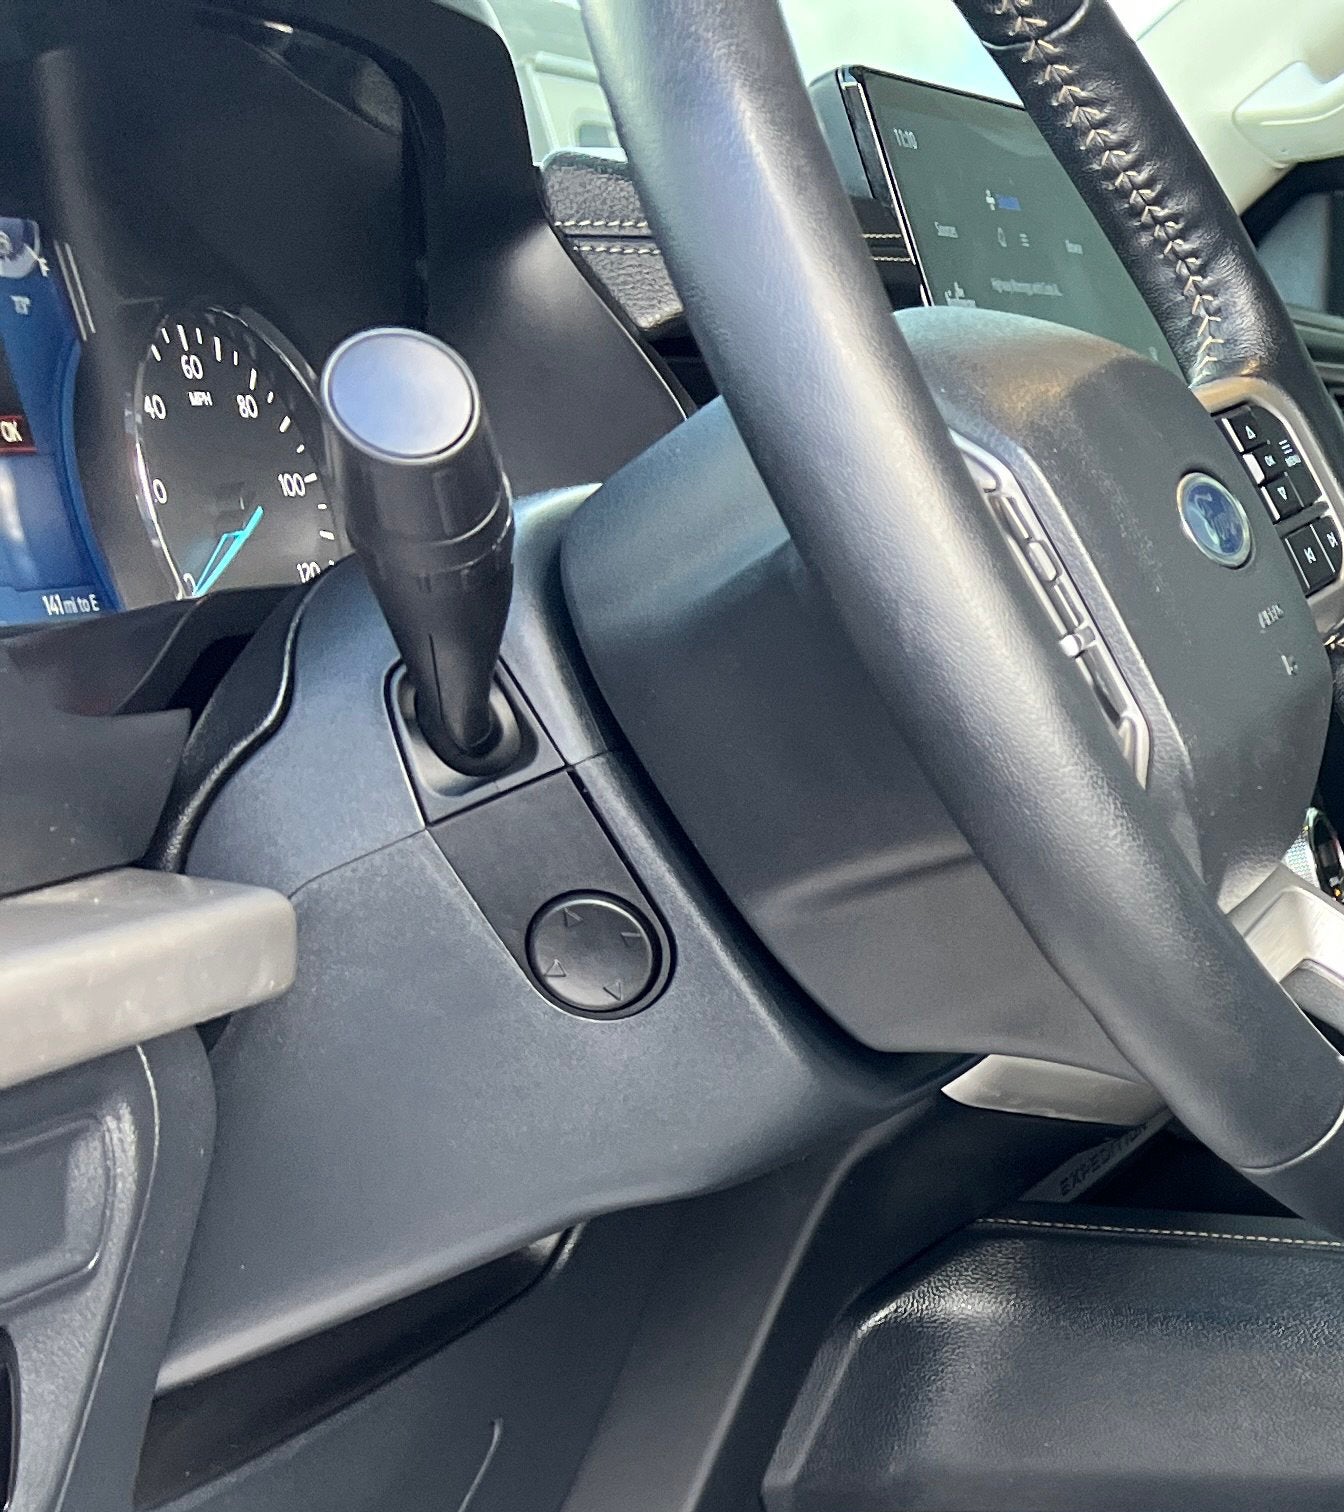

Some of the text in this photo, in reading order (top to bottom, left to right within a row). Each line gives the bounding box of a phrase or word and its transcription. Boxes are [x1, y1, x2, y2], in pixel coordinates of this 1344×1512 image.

[181, 355, 203, 379] 60
[144, 394, 166, 419] 40
[188, 391, 213, 406] MPH
[236, 394, 258, 418] 80
[278, 473, 305, 497] 100
[42, 594, 64, 615] 141
